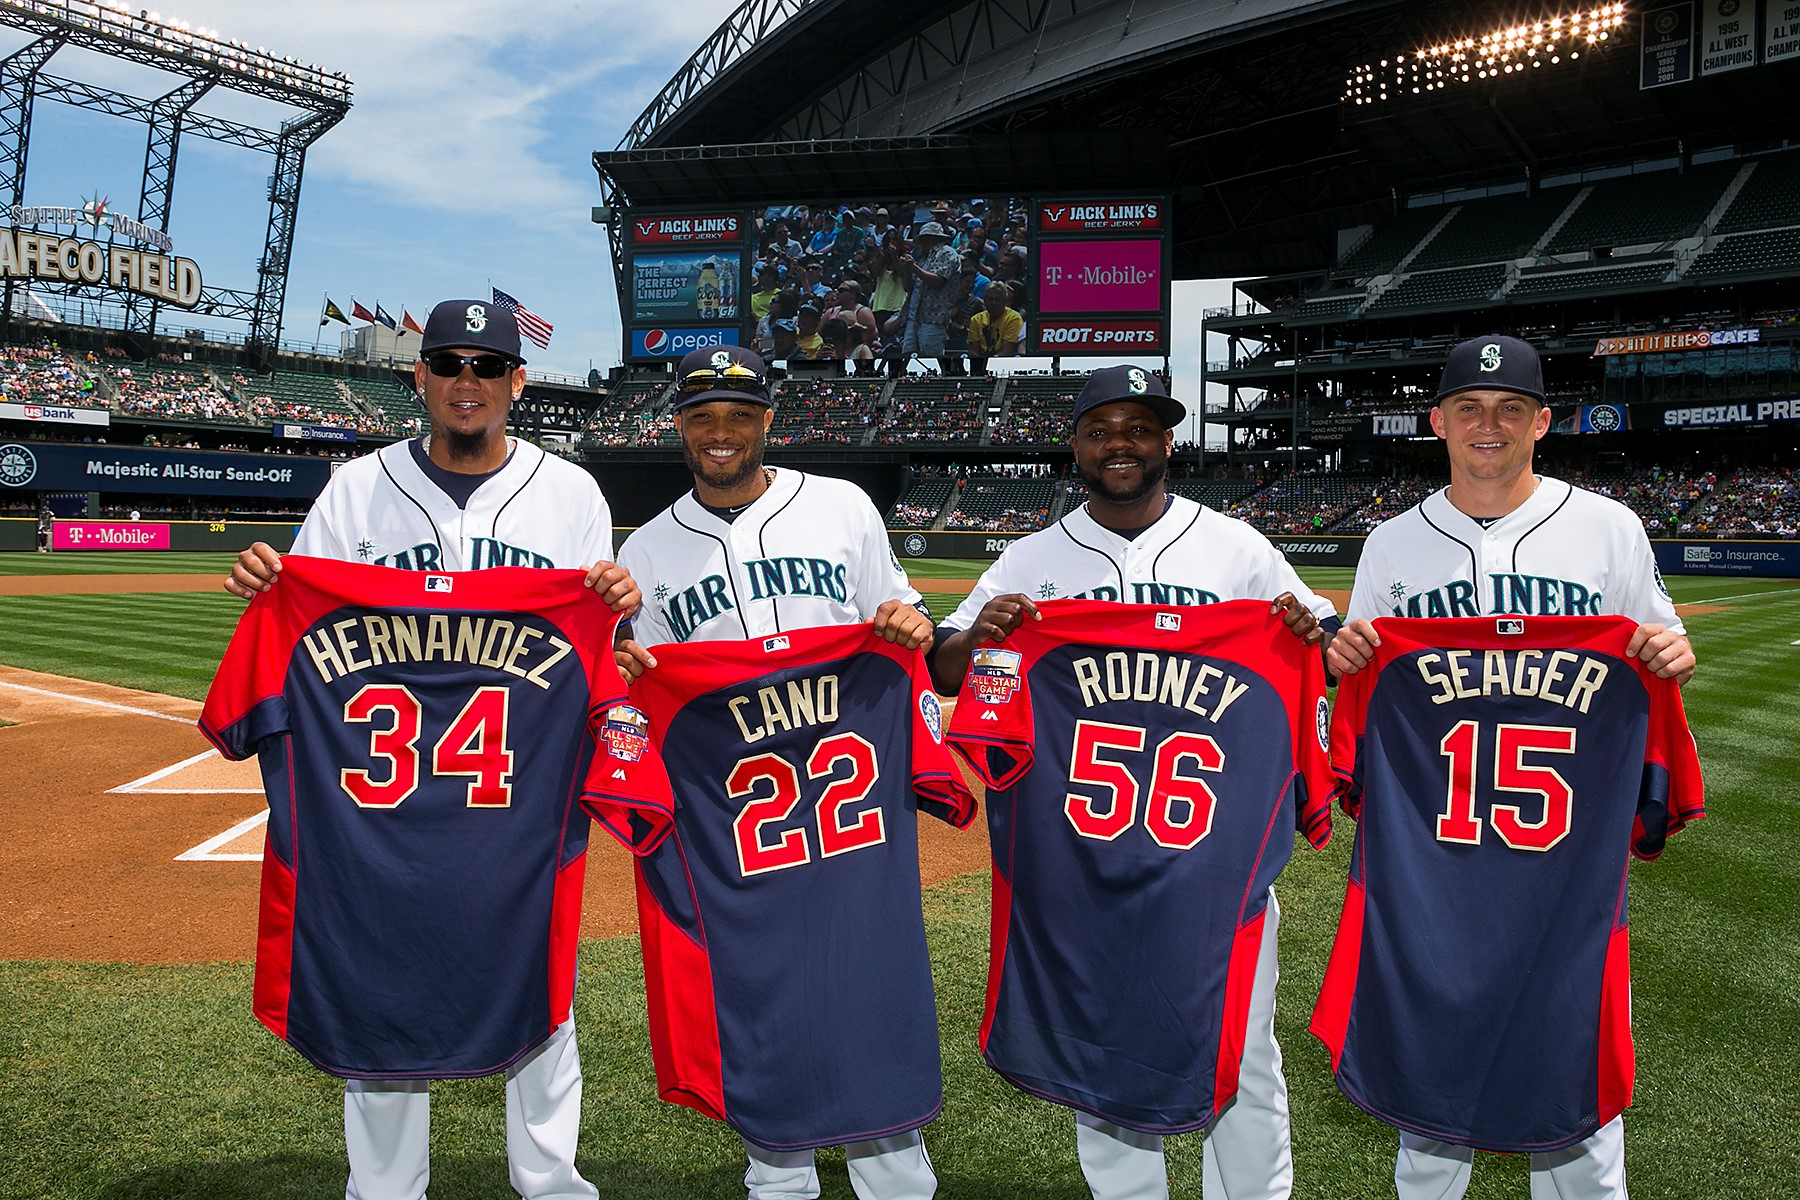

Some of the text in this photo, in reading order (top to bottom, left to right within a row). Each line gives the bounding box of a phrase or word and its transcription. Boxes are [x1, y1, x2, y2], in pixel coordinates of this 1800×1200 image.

[1718, 21, 1739, 36] 1995
[1773, 28, 1788, 40] A.L.
[1645, 38, 1689, 54] CHAMPIONSHIP
[1709, 34, 1749, 54] A.L. WEST
[1655, 48, 1677, 59] SERIES
[1658, 57, 1675, 66] 1995
[1703, 50, 1753, 71] CHAMPIONS
[1657, 65, 1674, 74] 2000
[1657, 73, 1674, 83] 2001
[1069, 204, 1157, 220] JACK LINK'S
[11, 205, 173, 252] SEATTLE MARINERS
[659, 217, 737, 233] JACK LINK'S
[1110, 220, 1142, 228] JERKY
[110, 247, 202, 307] FIELD
[637, 267, 660, 278] THE
[637, 277, 688, 288] PERFECT
[637, 289, 678, 299] LINEUP
[672, 331, 723, 352] pepsi
[1042, 328, 1155, 343] ROOT SPORTS
[1627, 328, 1760, 351] HIT IT HERE CAFE
[1664, 399, 1800, 425] SPECIAL PRE
[286, 427, 344, 439] Safeco Insurance
[1372, 415, 1418, 435] TION
[86, 461, 292, 483] Majestic All-Star Send-Off
[210, 523, 226, 533] 376
[1686, 548, 1780, 561] Safeco Insurance
[303, 614, 573, 690] HERNANDEZ
[972, 676, 1017, 688] ALL STAR
[980, 684, 1007, 695] GAME
[1072, 652, 1250, 724] RODNEY
[1416, 650, 1609, 714] SEAGER
[727, 674, 839, 744] CANO
[604, 730, 623, 741] ALL
[340, 683, 514, 809] 34
[612, 740, 638, 754] GAME
[1064, 718, 1226, 851] 56
[1435, 719, 1577, 852] 15
[724, 731, 887, 877] 22
